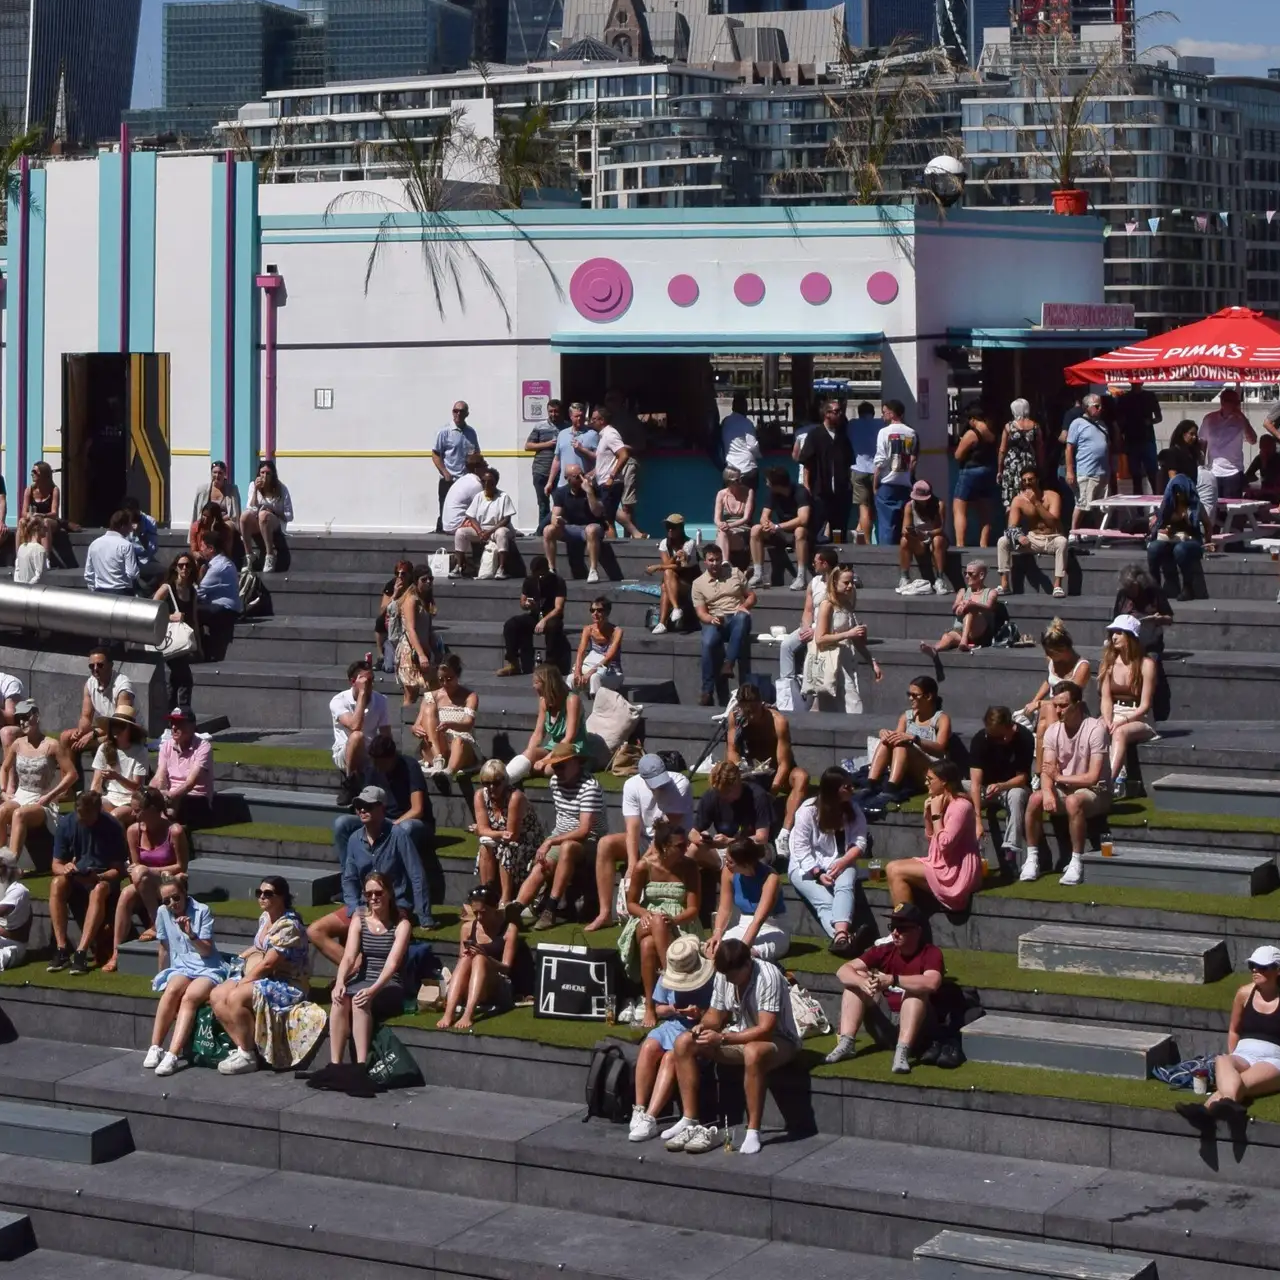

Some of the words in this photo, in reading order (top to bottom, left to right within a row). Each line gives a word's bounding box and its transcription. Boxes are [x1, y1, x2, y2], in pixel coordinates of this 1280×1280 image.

[1163, 343, 1246, 360] PIMM'S
[1105, 369, 1129, 382] TIME
[1132, 368, 1155, 380] FOR
[1158, 368, 1167, 380] A
[1169, 365, 1241, 381] SUNDOWNER
